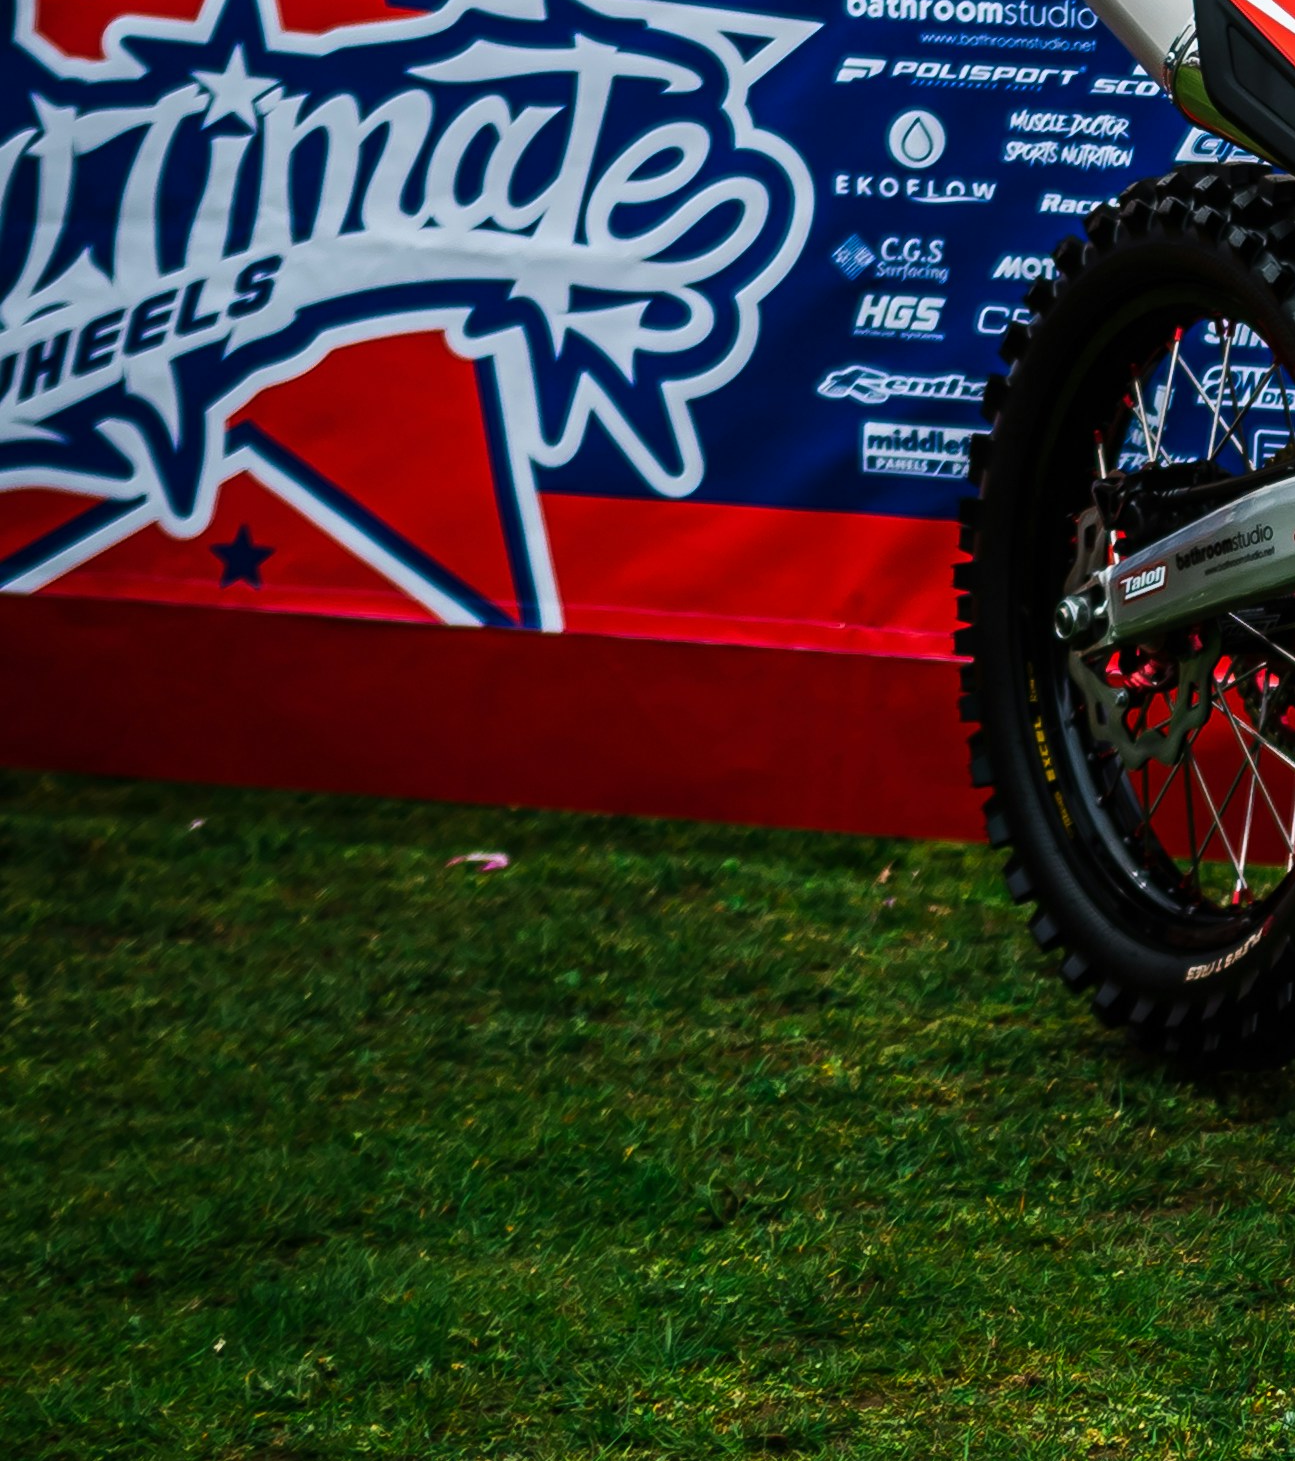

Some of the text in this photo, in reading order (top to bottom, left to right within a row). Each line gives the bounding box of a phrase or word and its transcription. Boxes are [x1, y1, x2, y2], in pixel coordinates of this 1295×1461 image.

[891, 60, 1080, 87] POLISPORT
[1004, 142, 1059, 166] SPORTS
[876, 258, 950, 284] Surfacing
[855, 293, 947, 331] HGS
[1175, 523, 1274, 572] bathroomstudio
[1120, 565, 1167, 601] Talon
